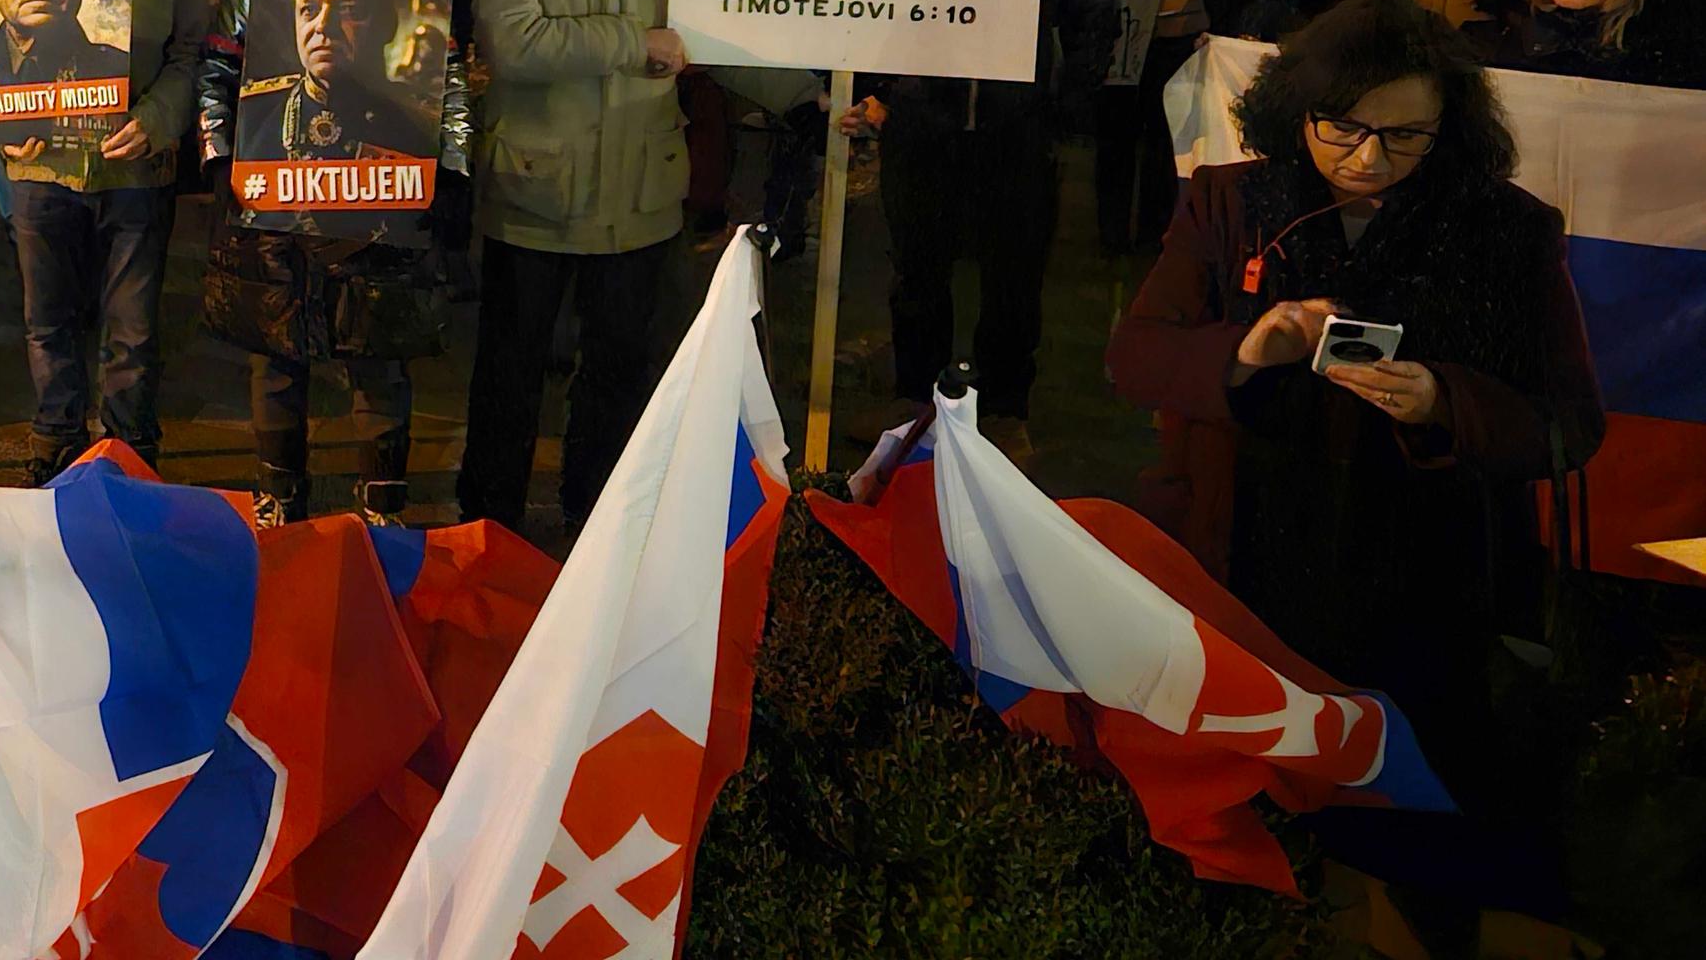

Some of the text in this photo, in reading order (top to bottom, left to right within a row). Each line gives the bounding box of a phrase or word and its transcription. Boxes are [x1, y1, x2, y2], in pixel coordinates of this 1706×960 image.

[909, 4, 977, 25] 6:10
[60, 84, 119, 109] MOCOU
[276, 164, 424, 203] DIKTUJEM
